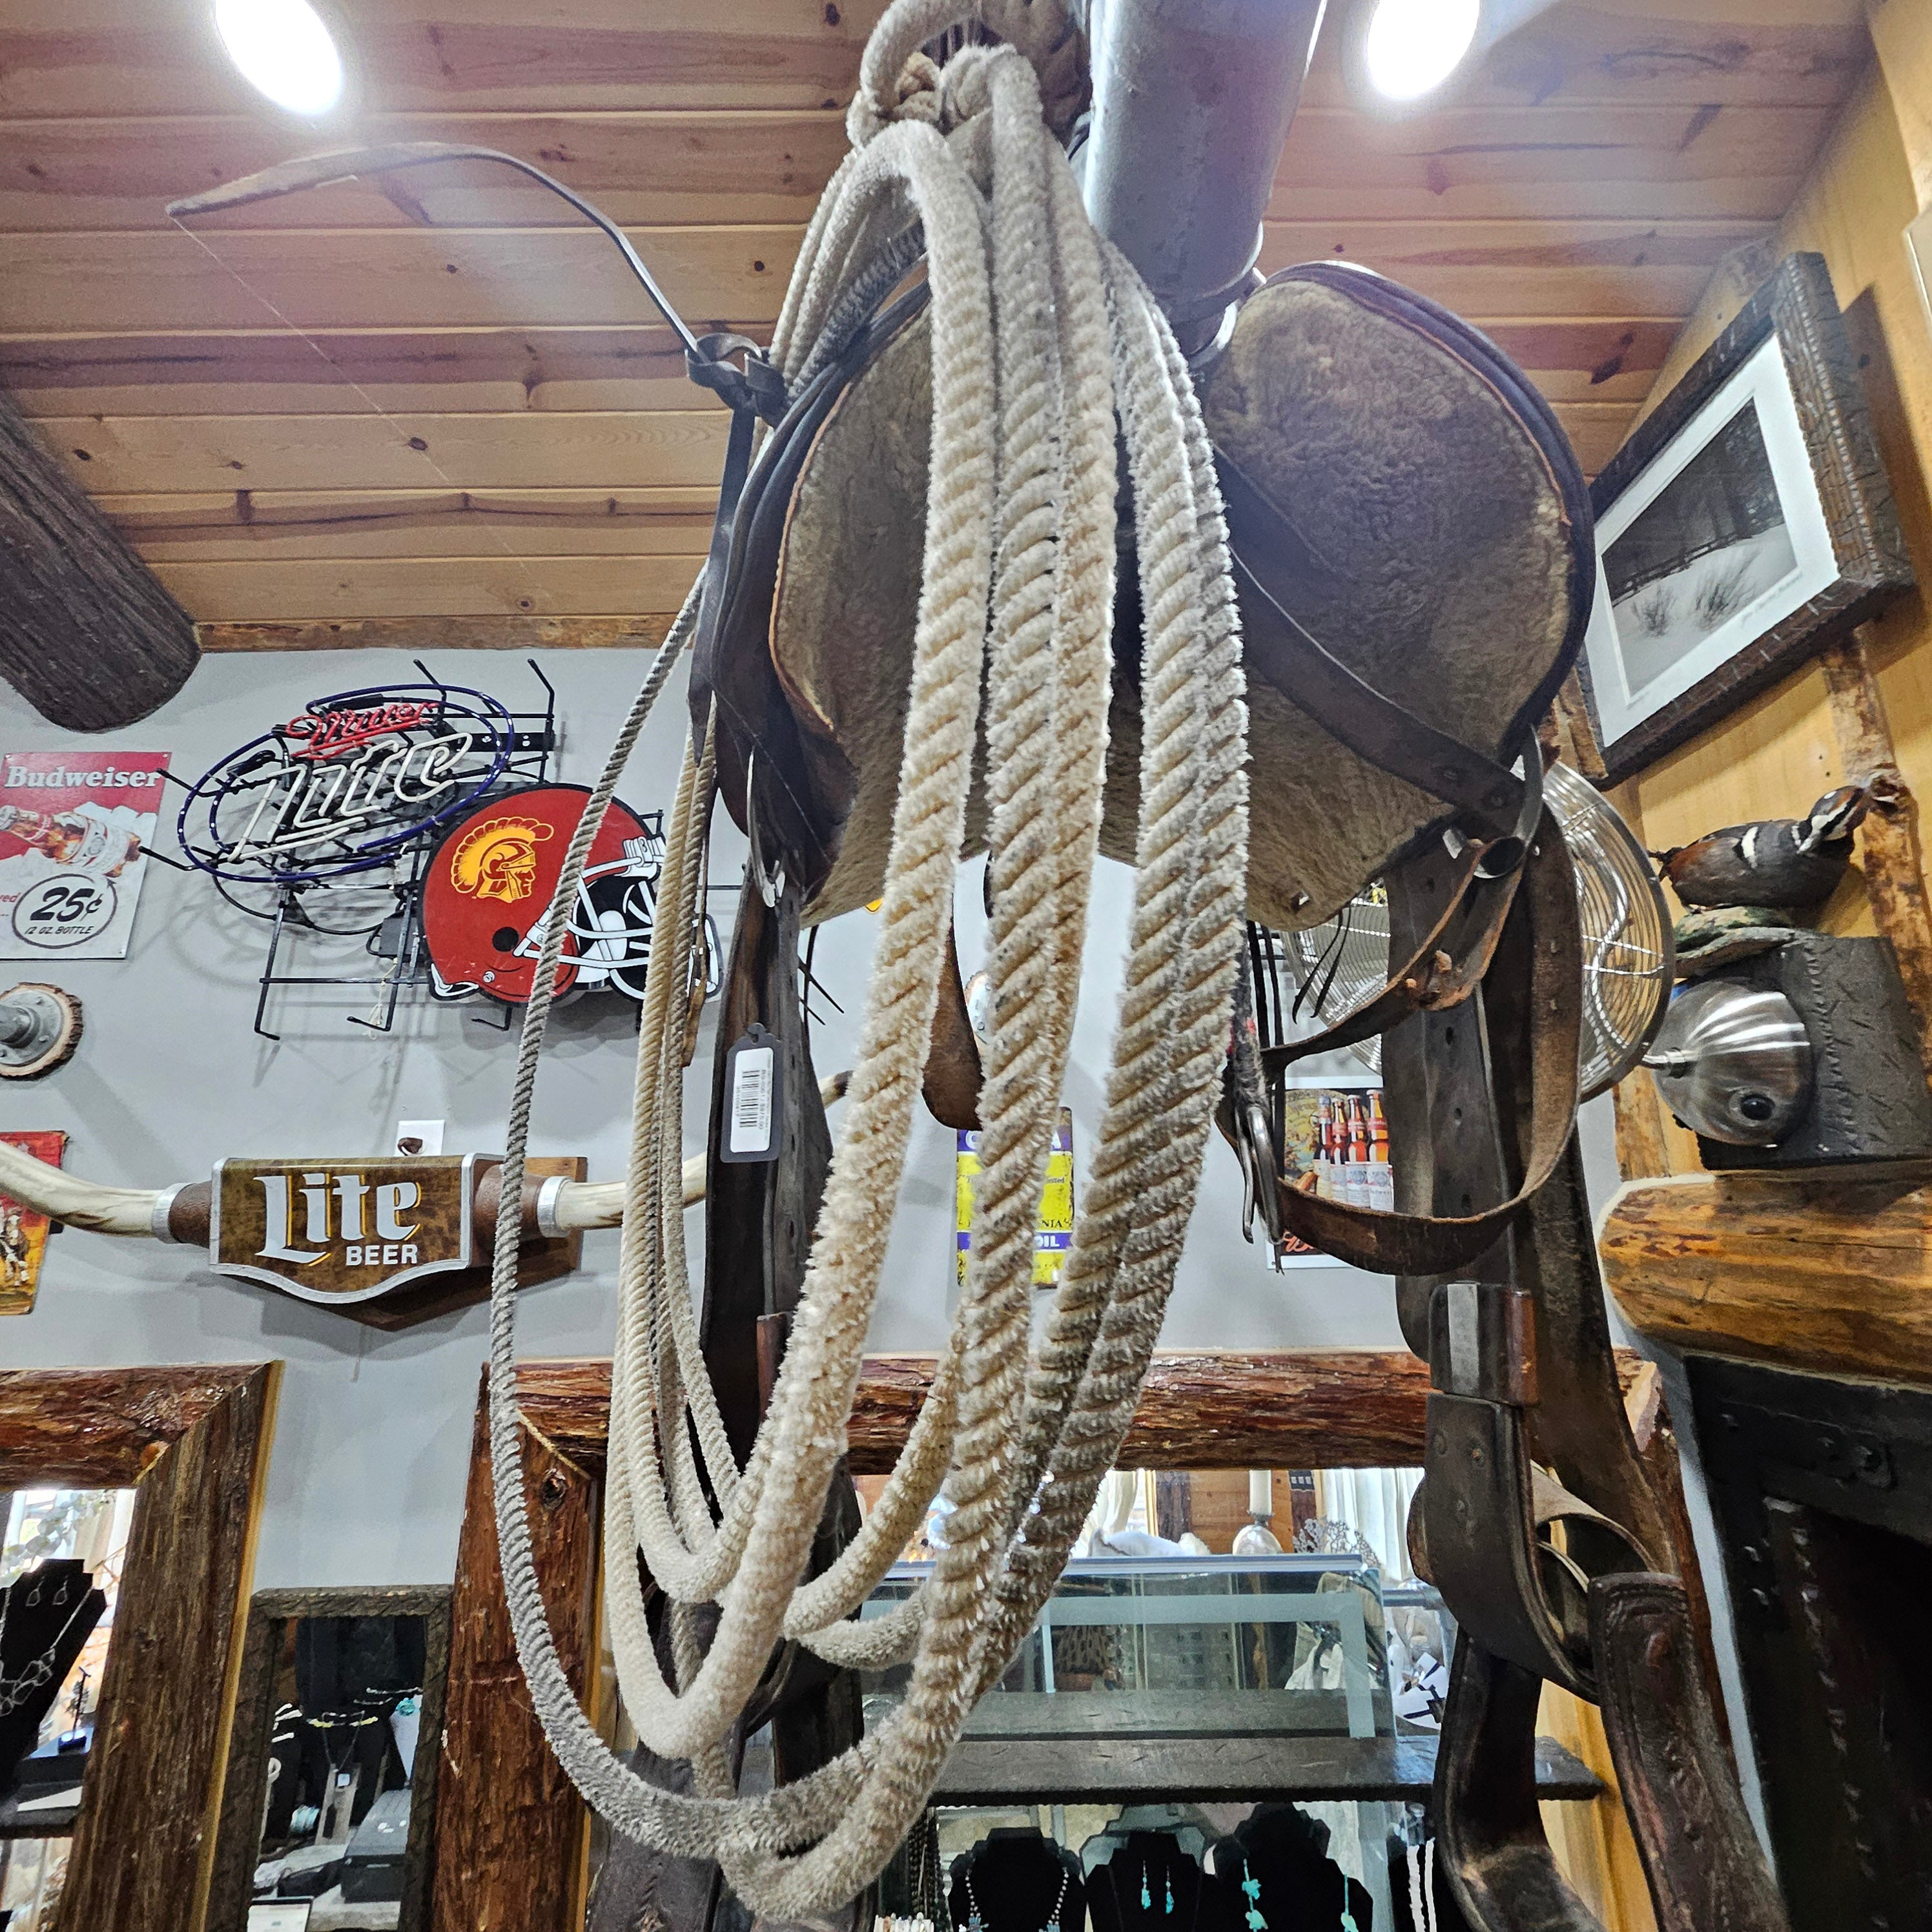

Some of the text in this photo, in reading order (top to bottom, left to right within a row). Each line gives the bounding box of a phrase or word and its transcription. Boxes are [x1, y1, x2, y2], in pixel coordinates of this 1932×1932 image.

[285, 703, 440, 759] Miller
[4, 766, 161, 788] Budweiser
[227, 733, 473, 861] Lite
[30, 887, 103, 922] 25¢
[25, 926, 37, 934] 12
[55, 926, 94, 934] BOTTLE
[252, 1173, 422, 1266] Lite
[345, 1244, 418, 1266] BEER
